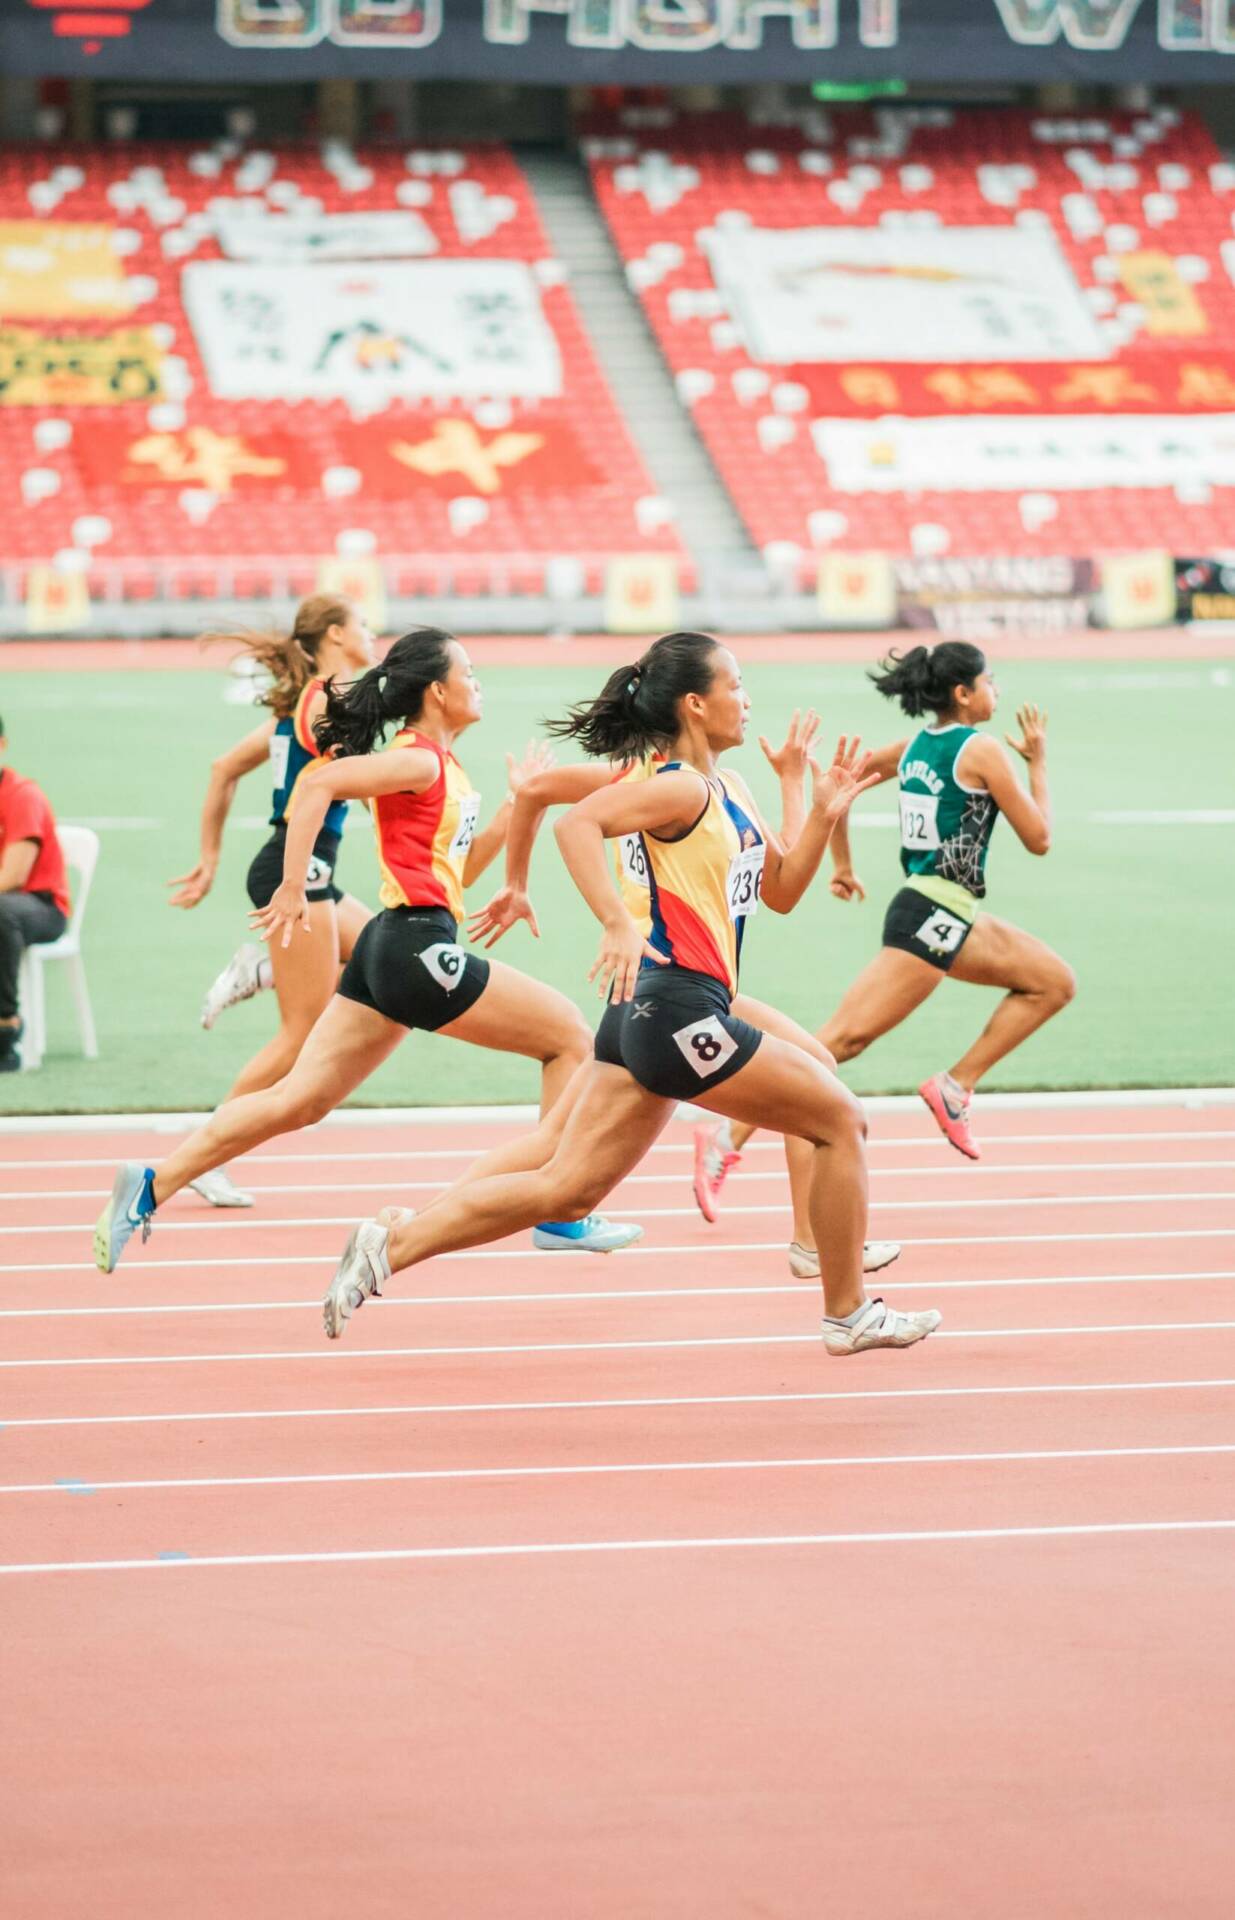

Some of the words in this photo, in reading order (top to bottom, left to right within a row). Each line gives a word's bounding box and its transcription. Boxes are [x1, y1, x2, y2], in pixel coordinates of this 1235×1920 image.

[932, 924, 953, 943] 4
[438, 951, 459, 976] 6
[691, 1032, 722, 1061] 8
